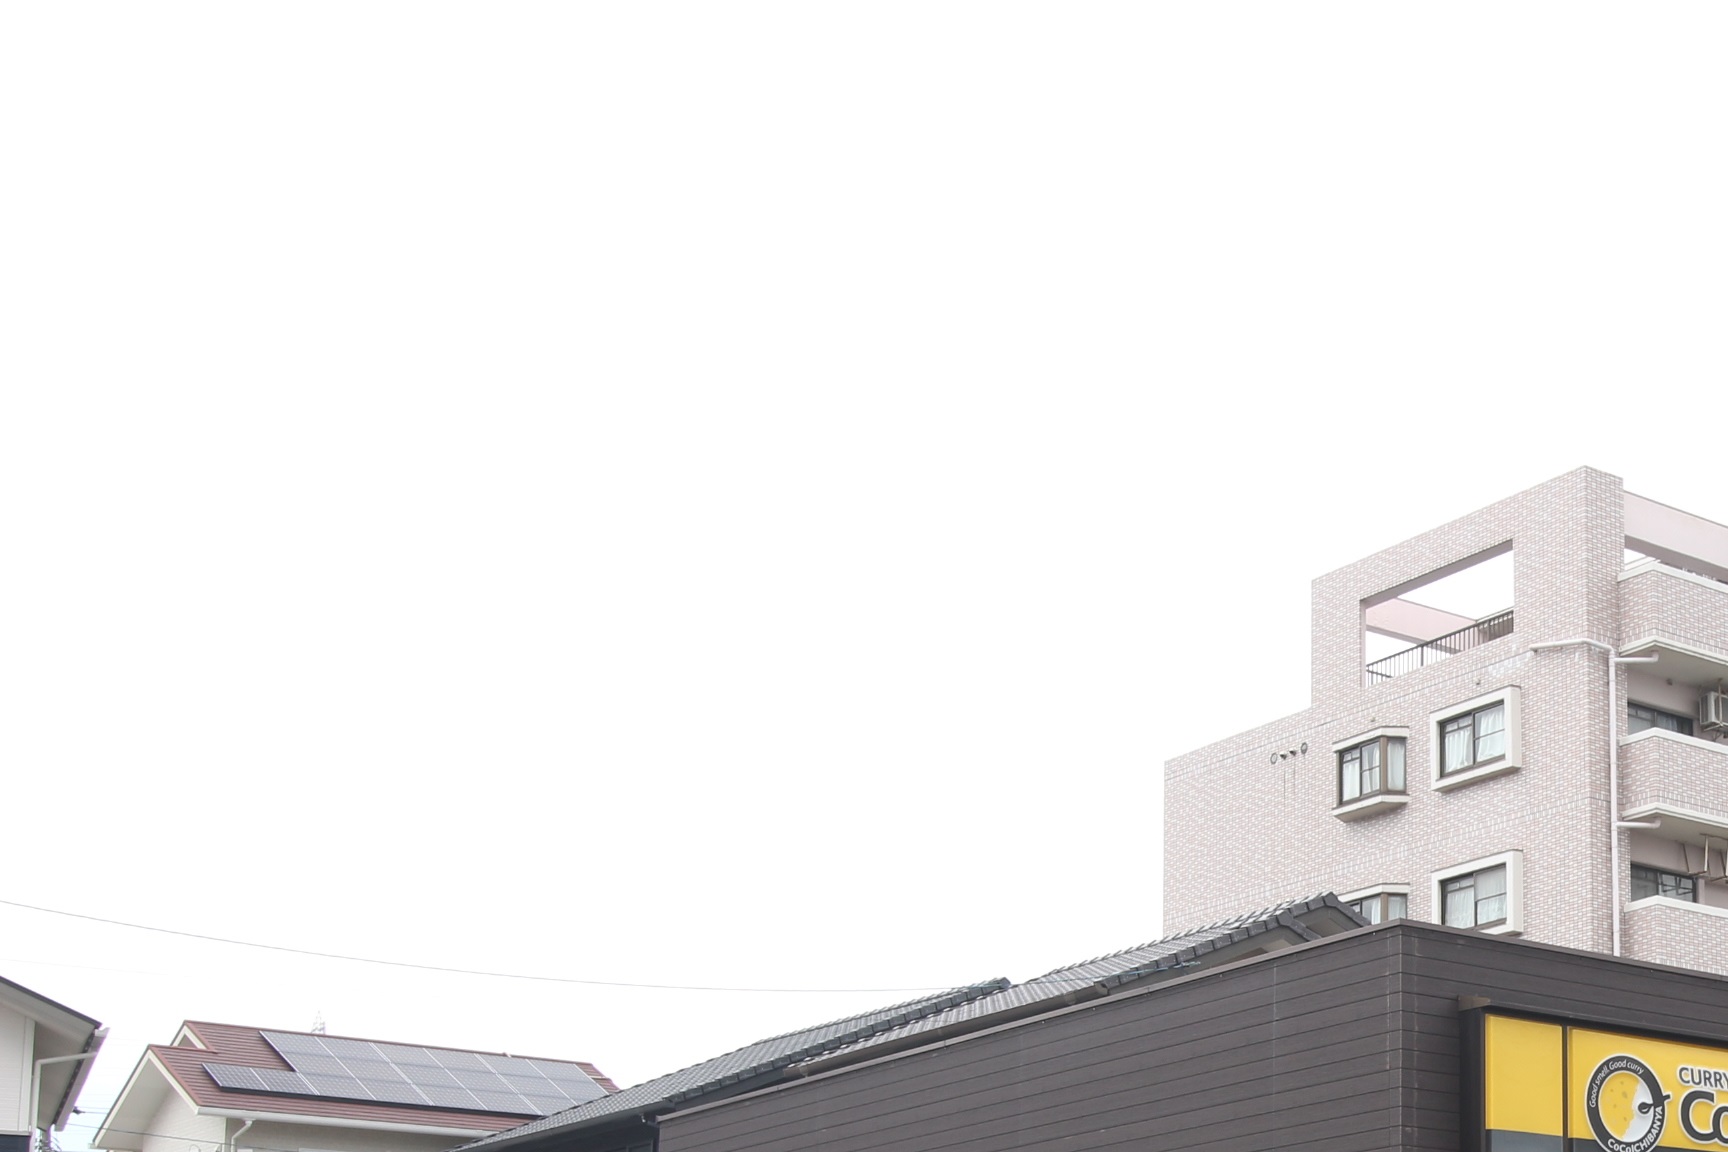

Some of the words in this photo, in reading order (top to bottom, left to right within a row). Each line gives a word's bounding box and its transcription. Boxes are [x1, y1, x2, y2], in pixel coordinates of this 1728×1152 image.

[1589, 1083, 1598, 1108] Good
[1609, 1059, 1626, 1070] Good
[1627, 1062, 1644, 1075] curry
